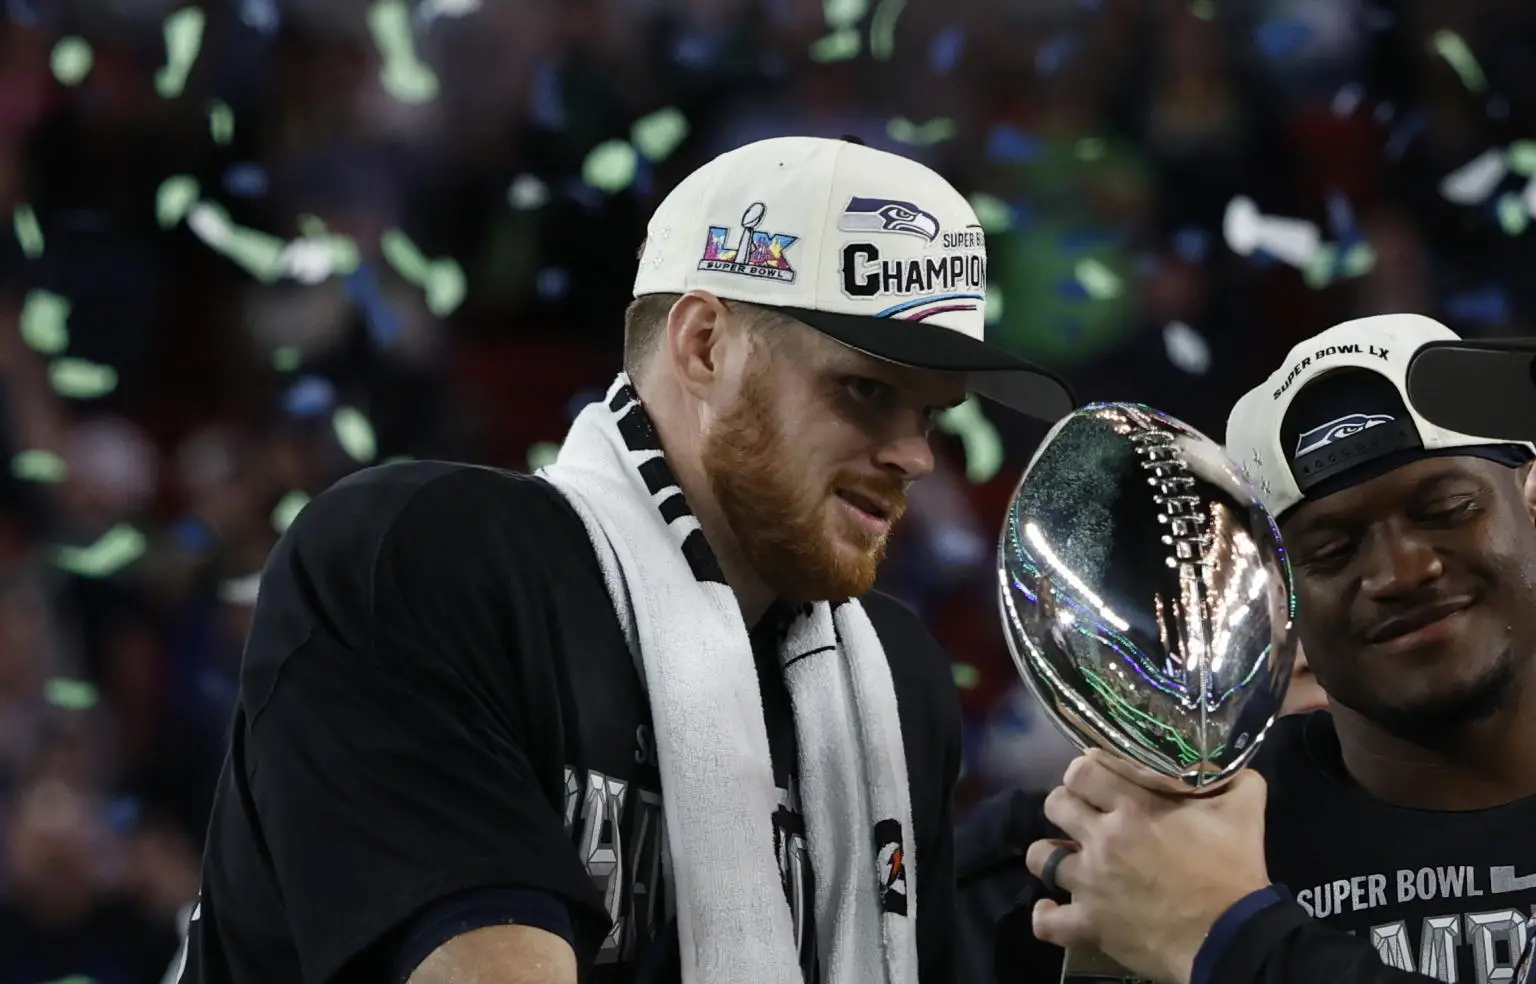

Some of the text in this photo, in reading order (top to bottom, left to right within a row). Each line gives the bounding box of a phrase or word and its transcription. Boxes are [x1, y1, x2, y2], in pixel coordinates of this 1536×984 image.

[943, 232, 974, 248] SUPER
[706, 261, 784, 278] SUPER BOWL
[1273, 344, 1390, 400] SUPER BOWL LX
[1297, 873, 1388, 919] SUPER
[1397, 866, 1483, 903] BOWL
